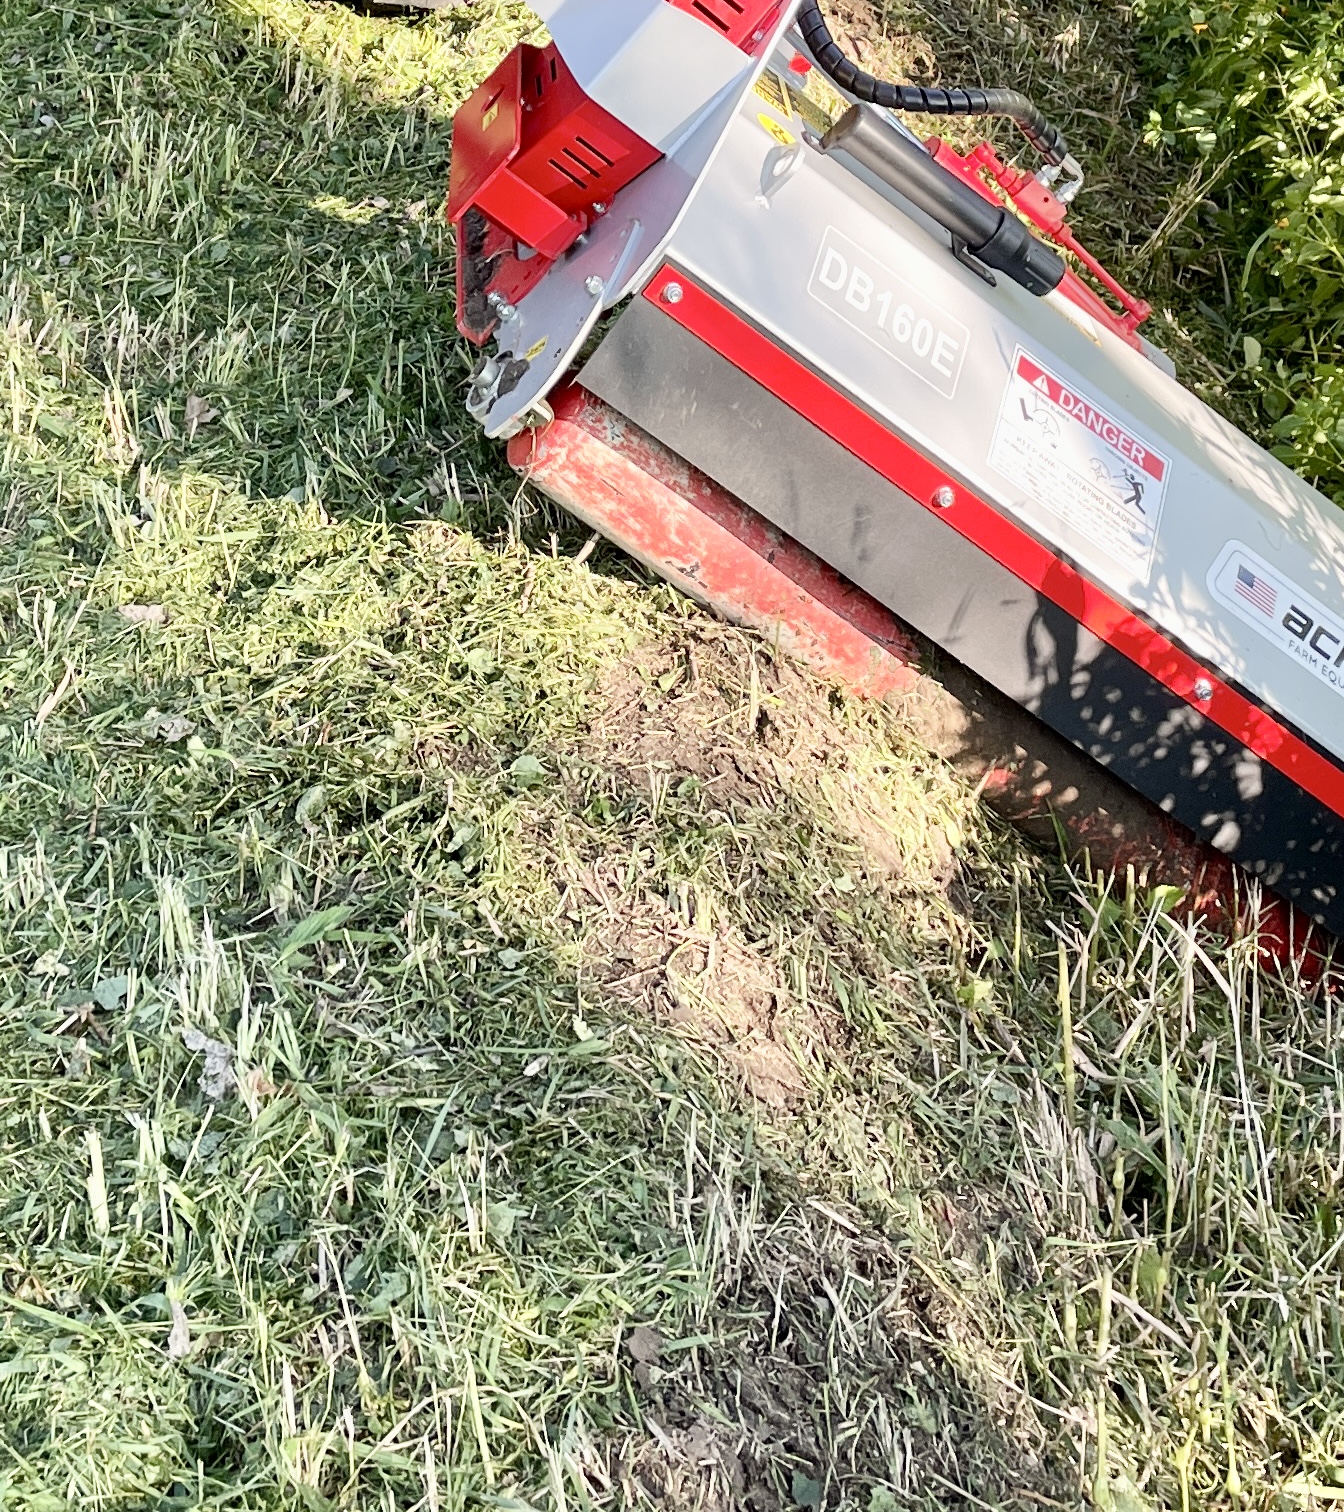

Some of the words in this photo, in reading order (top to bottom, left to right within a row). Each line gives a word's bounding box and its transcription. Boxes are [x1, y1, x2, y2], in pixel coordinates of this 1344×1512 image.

[818, 246, 960, 379] DB160E
[1058, 388, 1146, 467] DANGER
[1287, 638, 1318, 669] FARM
